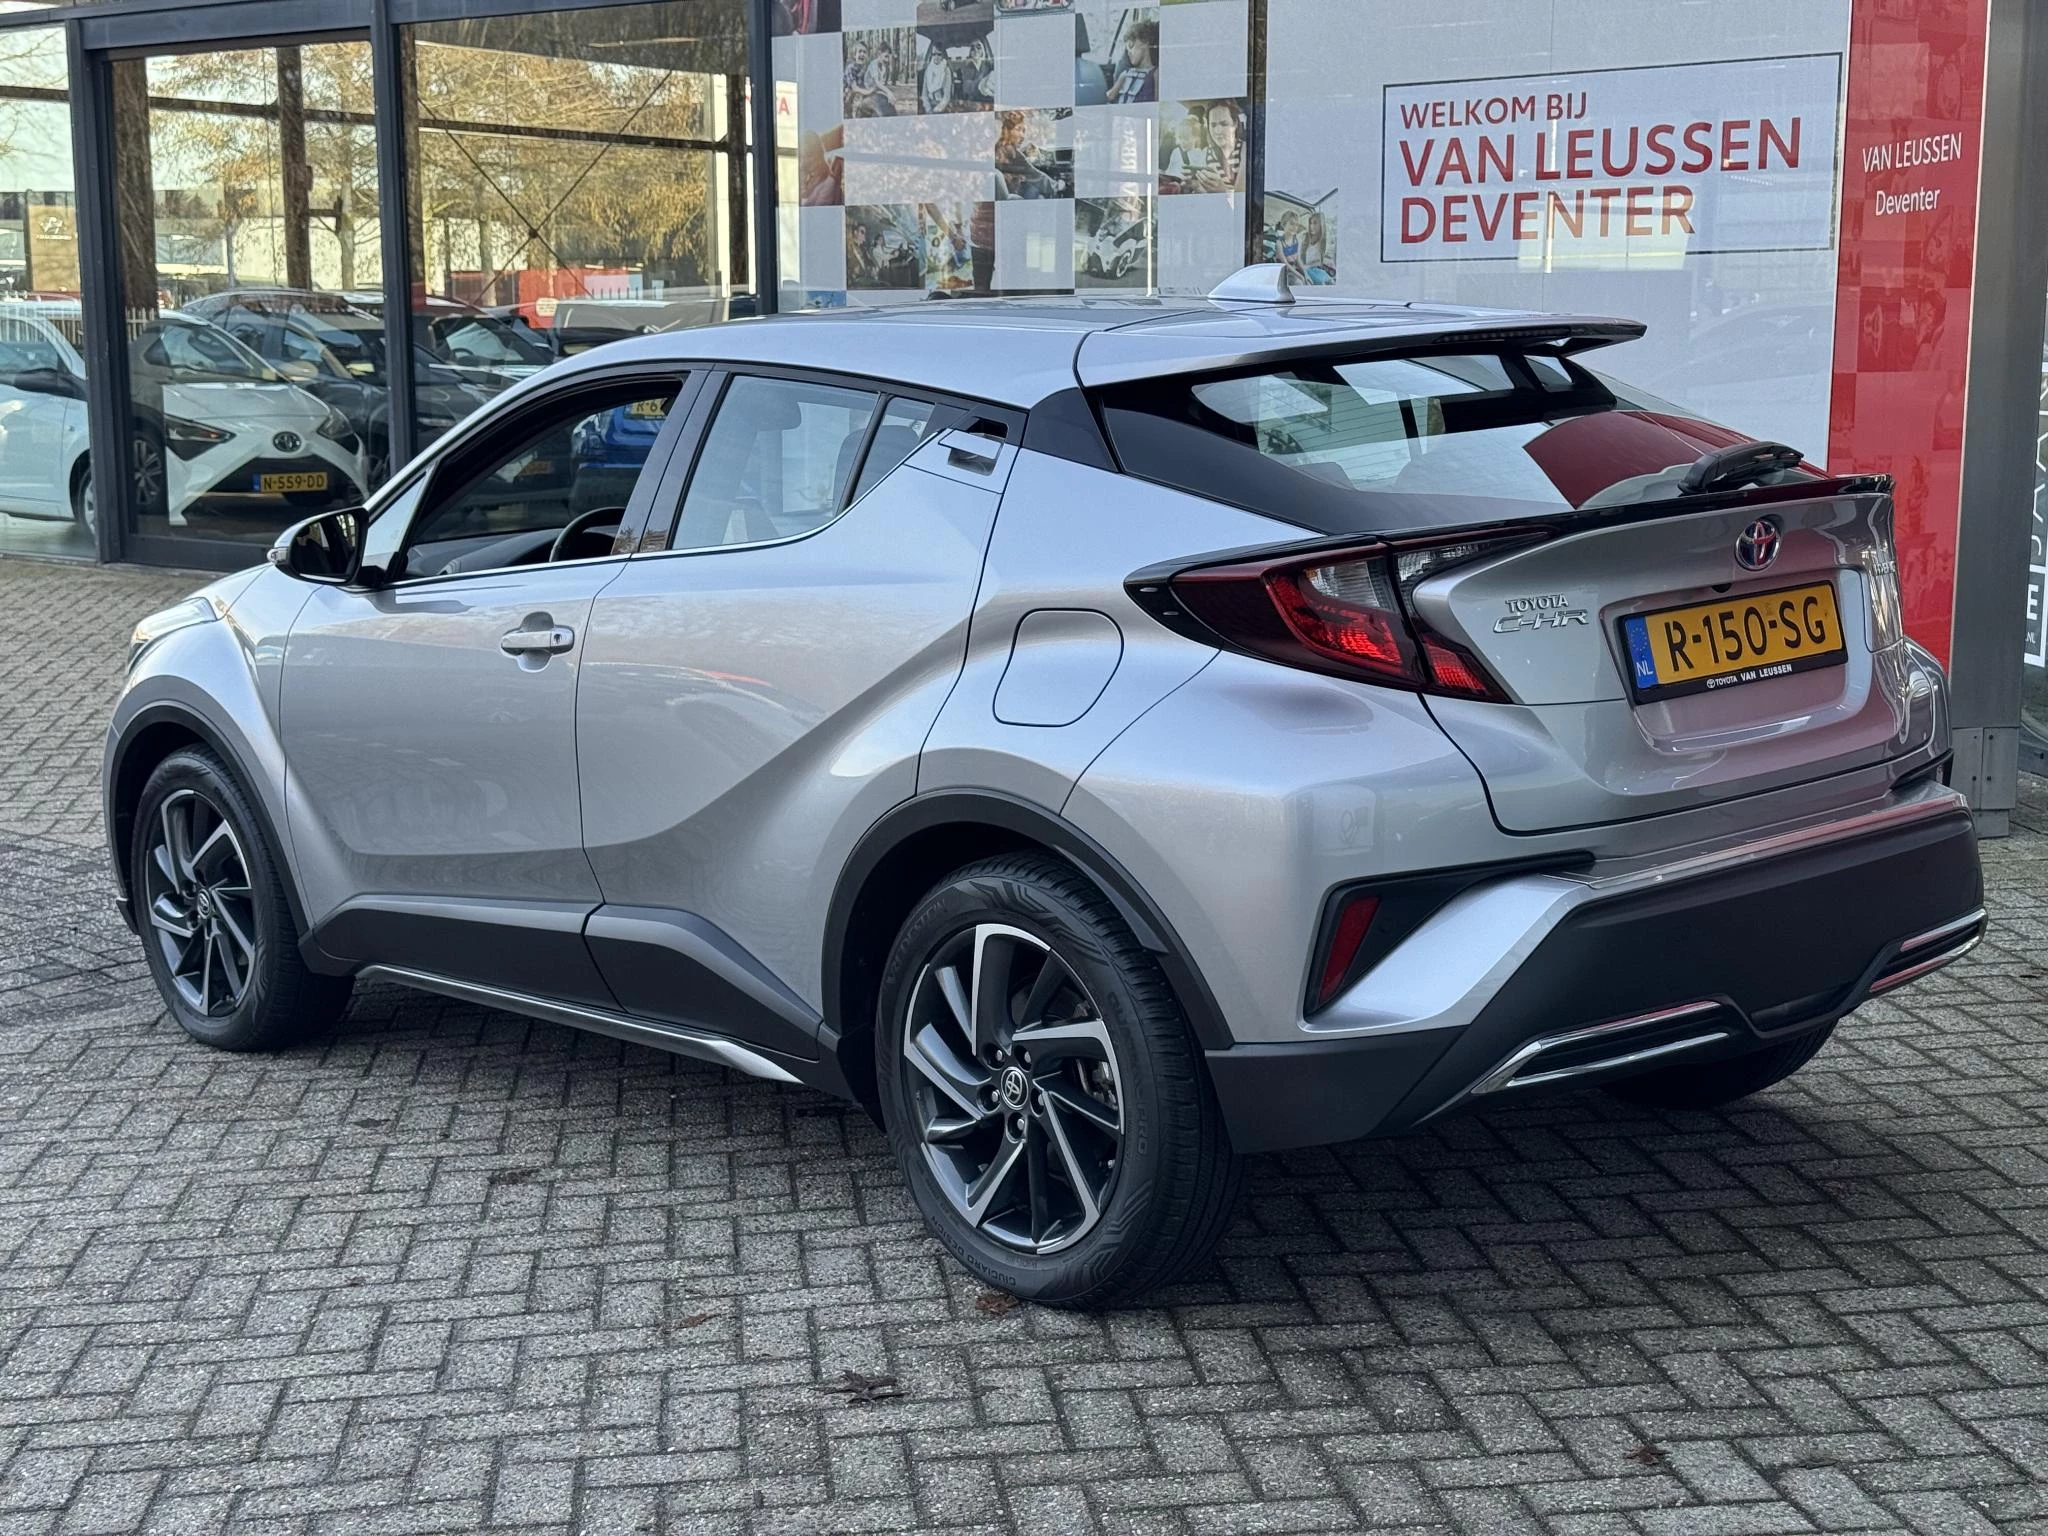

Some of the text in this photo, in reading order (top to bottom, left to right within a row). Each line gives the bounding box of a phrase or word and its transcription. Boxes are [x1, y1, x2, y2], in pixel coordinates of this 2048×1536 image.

[1400, 91, 1587, 130] WELKOM BIJ
[1399, 117, 1801, 187] VAN LEUSSEN
[1862, 132, 1962, 173] VAN LEUSSEN
[1401, 184, 1696, 244] DEVENTER
[1875, 186, 1941, 216] Deventer
[263, 474, 326, 491] N-559-DD
[1505, 593, 1569, 613] TOYOTA
[1493, 609, 1589, 634] C-HR
[1636, 596, 1827, 677] NL R-150-SG
[1715, 663, 1793, 686] TOYOTA VAN LEUSSEN
